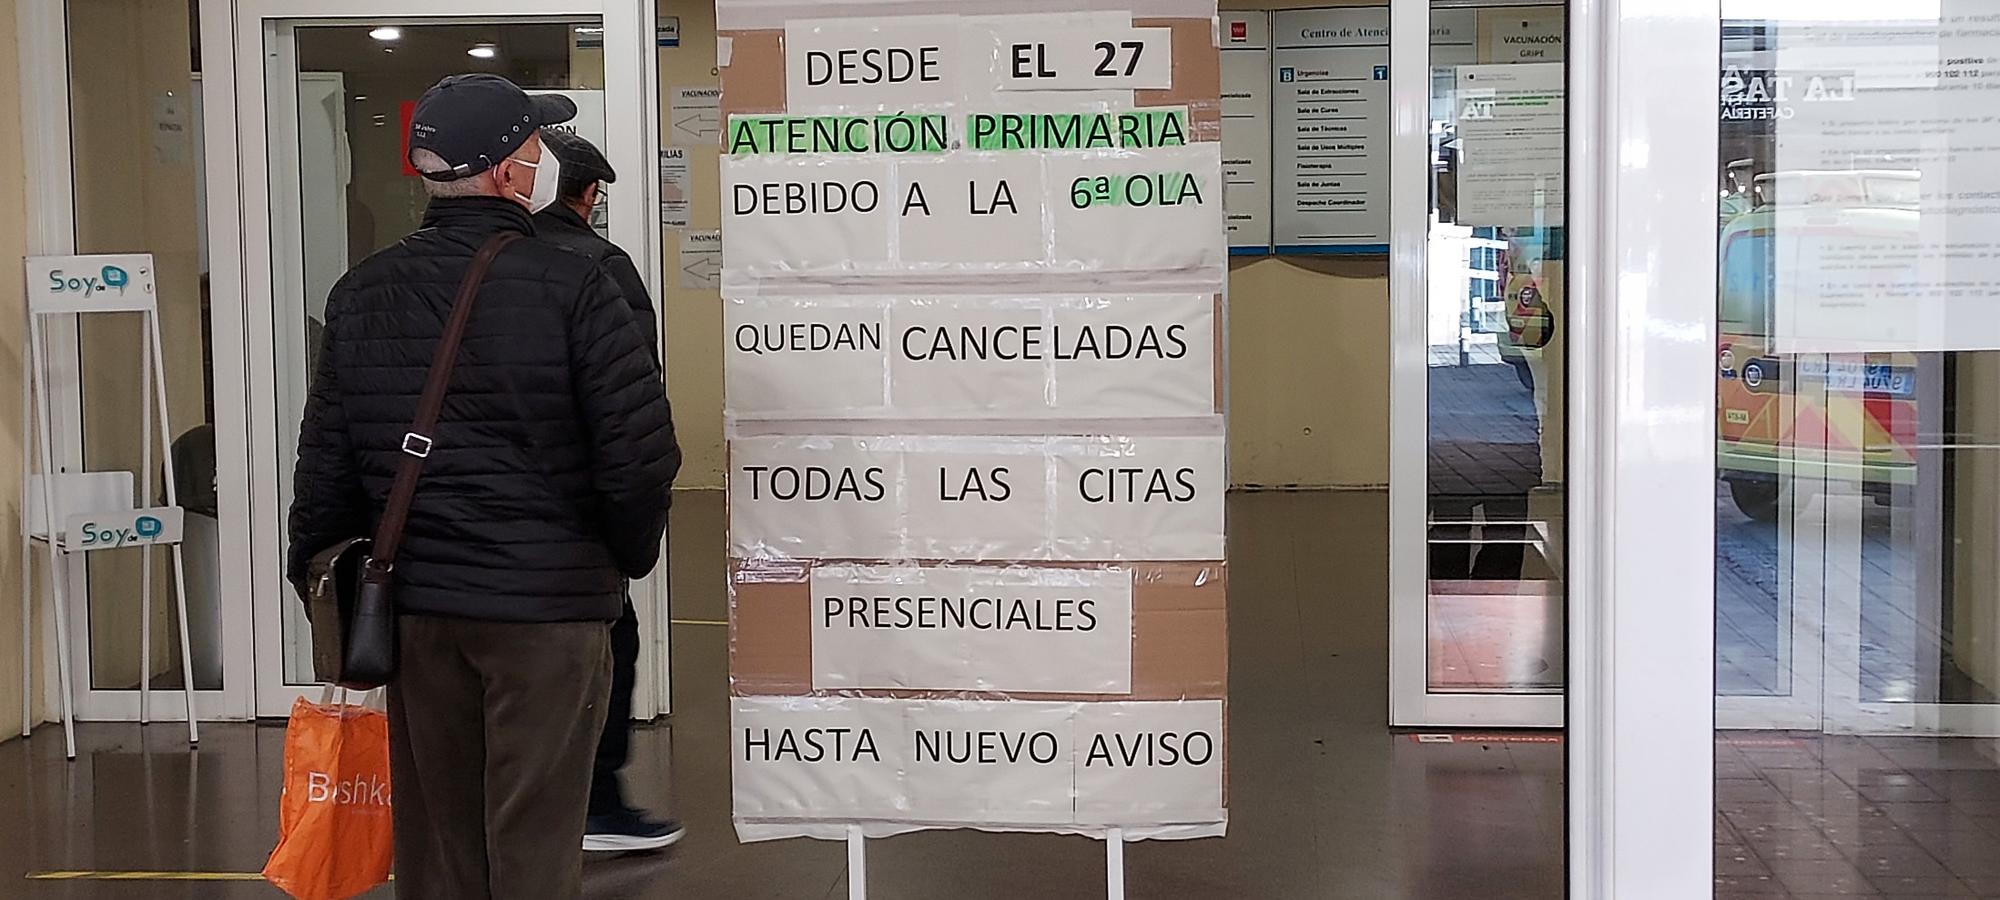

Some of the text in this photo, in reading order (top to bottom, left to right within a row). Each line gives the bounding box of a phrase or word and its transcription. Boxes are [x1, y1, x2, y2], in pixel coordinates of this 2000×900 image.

[1301, 28, 1337, 39] Centro
[1340, 27, 1351, 38] de
[806, 41, 1145, 86] DESDE EL 27
[1519, 49, 1545, 57] GRIPE
[731, 111, 1187, 155] ATENCIÓN PRIMARIA
[732, 172, 1204, 217] DEBIDO A LA 6ª OLA
[49, 269, 97, 297] Soy
[734, 322, 882, 356] QUEDAN
[743, 465, 1196, 504] TODAS LAS CITAS
[81, 522, 130, 549] Soy
[824, 596, 1098, 632] PRESENCIALES
[743, 727, 1214, 768] HASTA NUEVO AVISO
